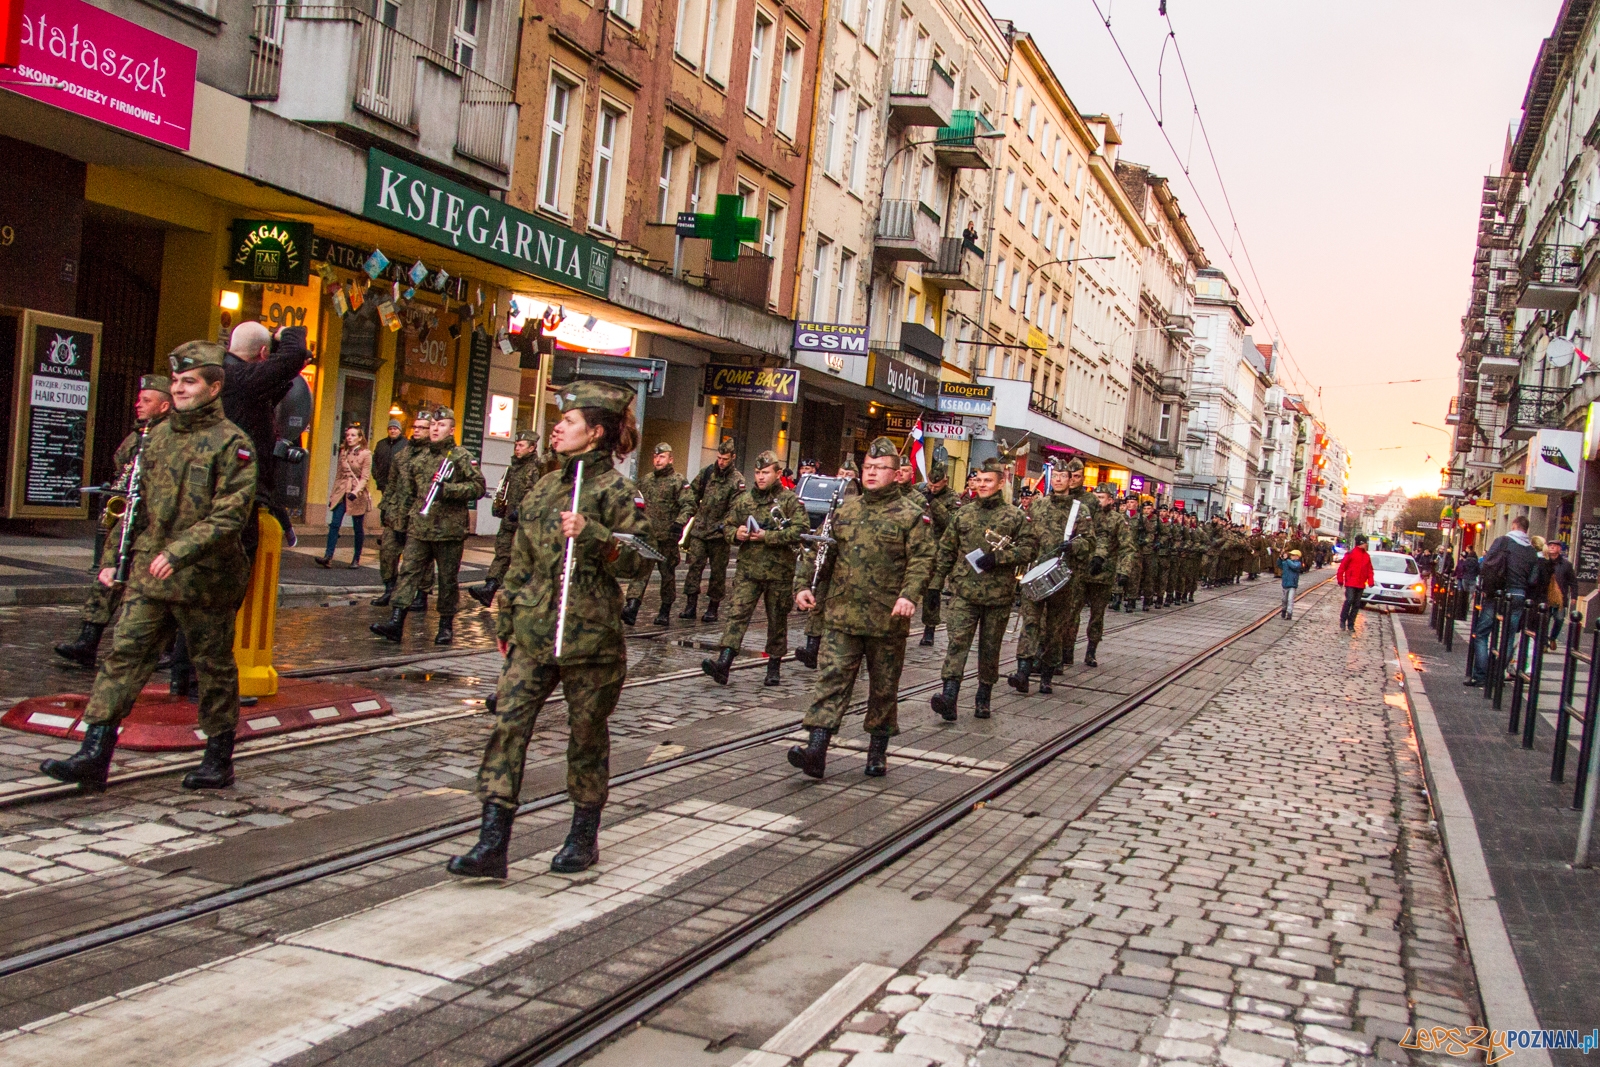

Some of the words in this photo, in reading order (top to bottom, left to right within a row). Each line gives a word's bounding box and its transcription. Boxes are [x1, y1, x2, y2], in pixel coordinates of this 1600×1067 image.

[4, 63, 58, 86] SKONT
[110, 98, 161, 126] FIRMOWEJ
[377, 166, 582, 280] KSIĘGARNIA
[236, 225, 299, 269] KSIĘGARNIA
[257, 252, 277, 263] TAK
[592, 251, 607, 268] TAK
[799, 323, 866, 335] TELEFONY
[798, 333, 865, 351] GSM
[412, 339, 448, 367] -90%
[713, 368, 754, 390] COME
[754, 372, 794, 396] BACK
[887, 361, 898, 393] by
[898, 373, 903, 390] o
[35, 380, 58, 389] FRYZJER
[63, 383, 88, 392] STYLISTA
[944, 382, 991, 397] fotograf
[35, 390, 55, 402] HAIR
[56, 393, 87, 406] STUDIO
[941, 399, 971, 411] KSERO
[887, 418, 903, 427] THE
[926, 423, 964, 435] KSERO
